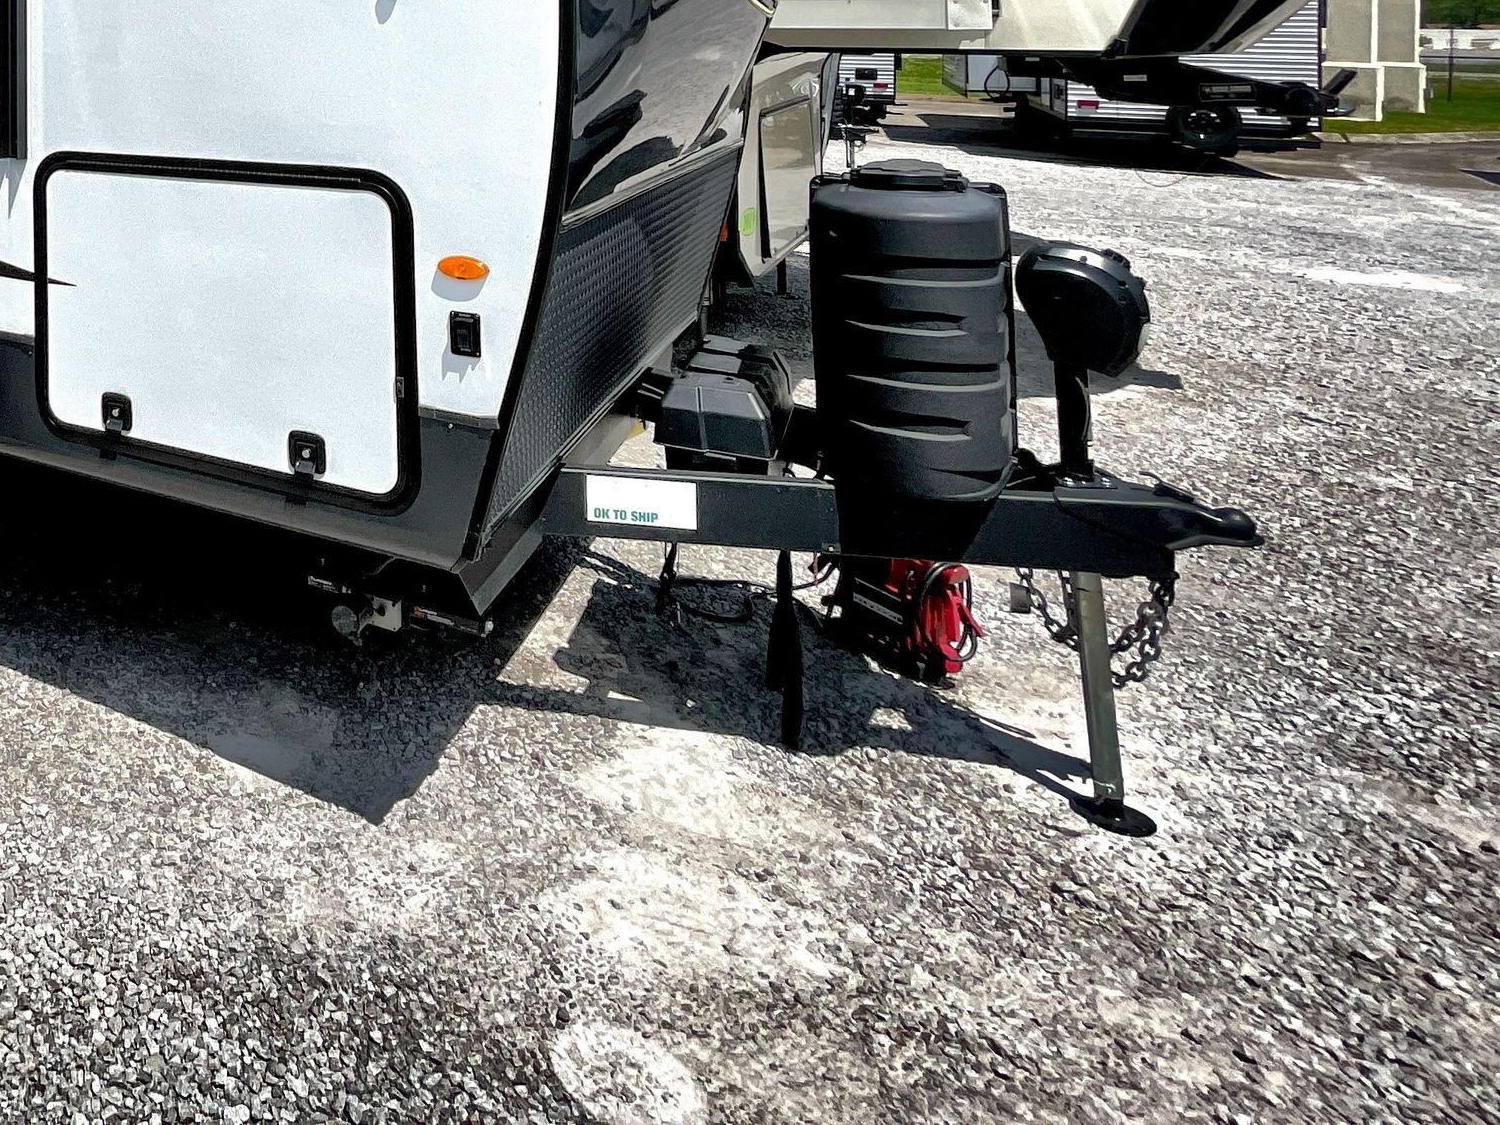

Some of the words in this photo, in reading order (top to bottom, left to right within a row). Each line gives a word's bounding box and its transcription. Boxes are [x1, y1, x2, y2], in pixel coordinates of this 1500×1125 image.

[594, 508, 610, 519] OK
[613, 509, 627, 521] TO
[631, 511, 659, 523] SHIP
